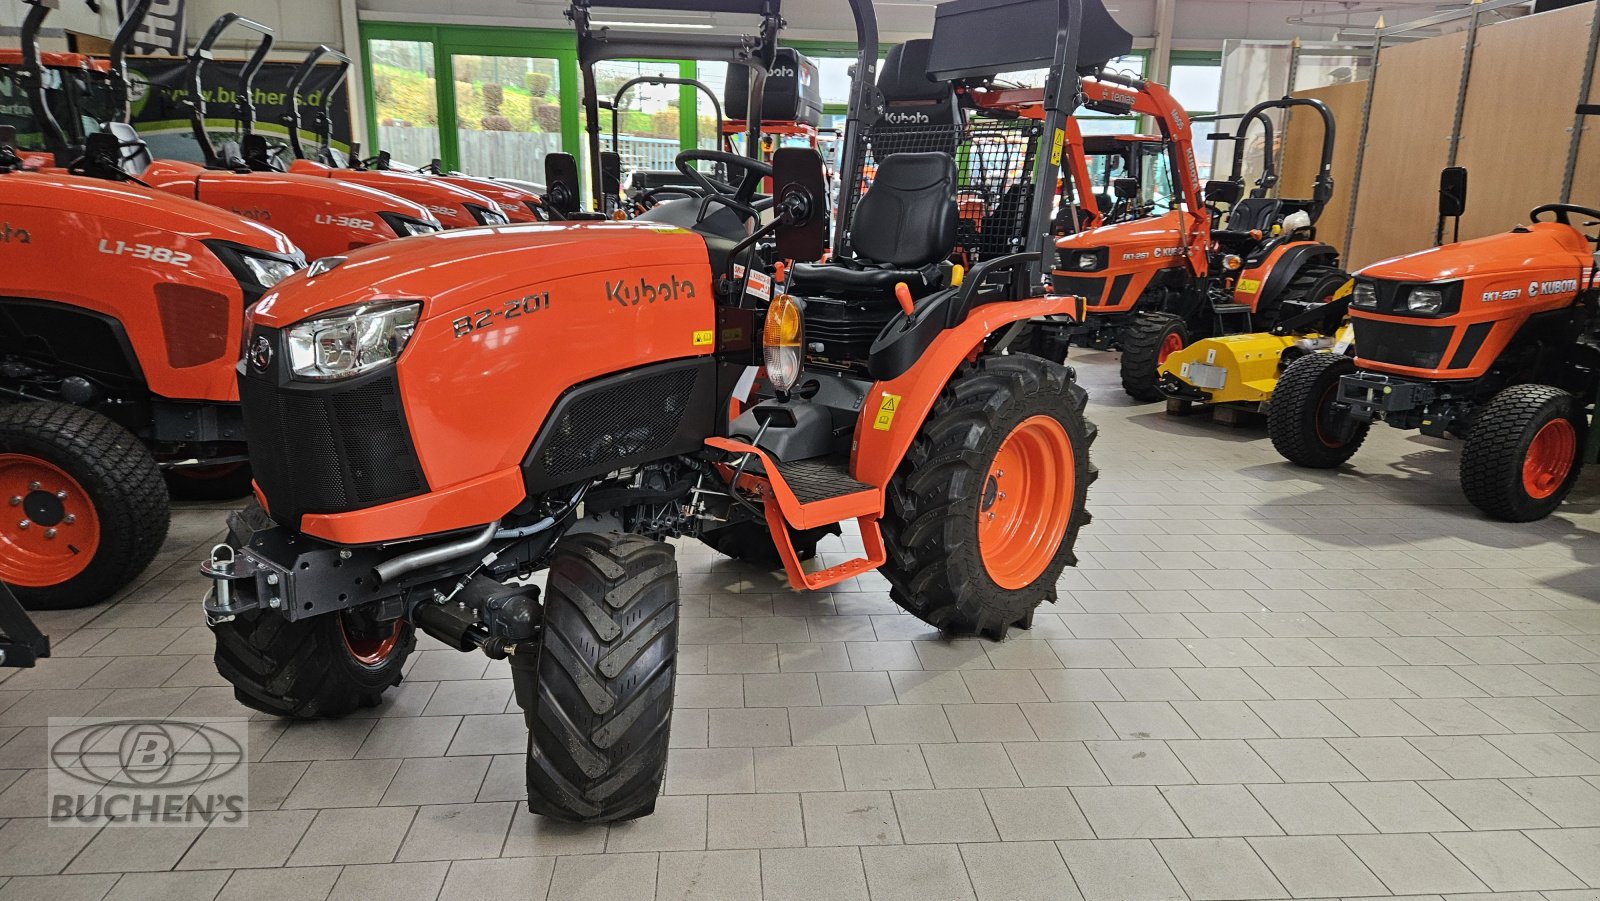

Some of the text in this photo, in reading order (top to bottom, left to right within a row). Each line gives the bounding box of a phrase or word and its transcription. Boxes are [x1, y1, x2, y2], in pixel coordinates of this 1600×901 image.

[885, 112, 930, 124] Kubota
[315, 213, 375, 231] L1-382
[98, 238, 193, 268] L1-382
[605, 275, 696, 307] Kubota
[1541, 279, 1577, 295] KUBOTA
[452, 291, 550, 339] B2-201
